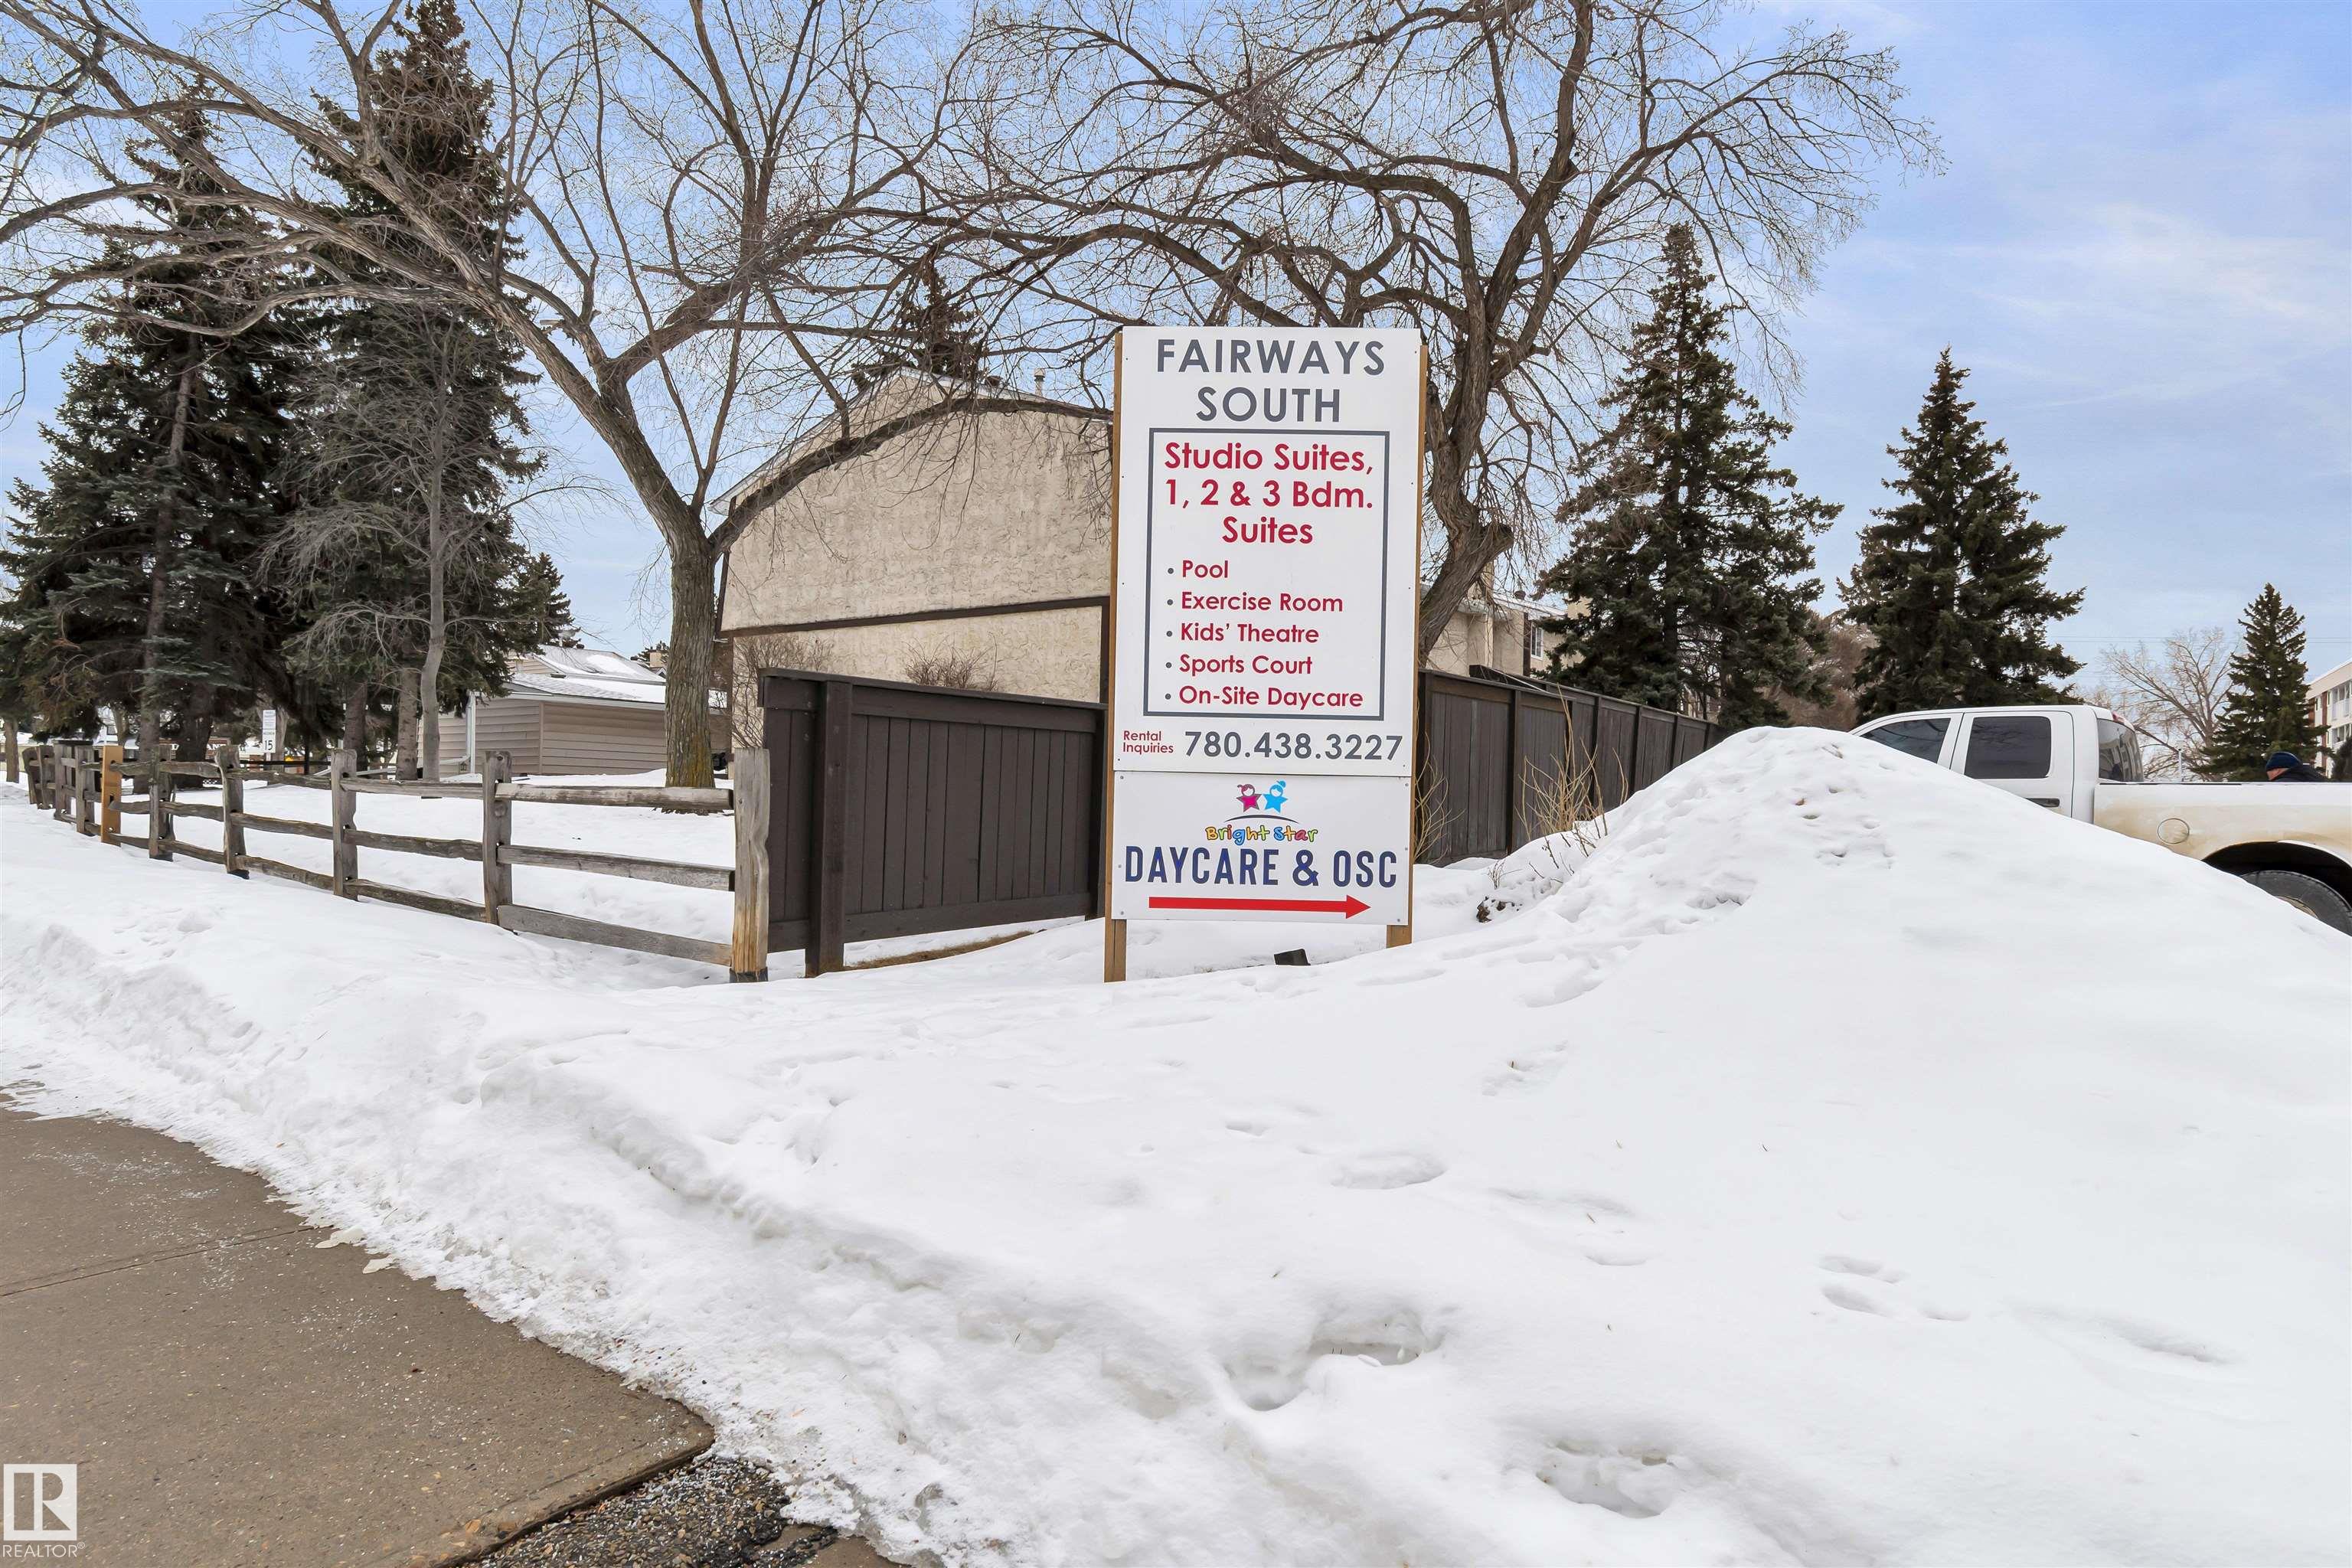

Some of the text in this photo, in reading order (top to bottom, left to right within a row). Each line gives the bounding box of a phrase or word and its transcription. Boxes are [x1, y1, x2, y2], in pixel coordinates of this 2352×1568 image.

[1157, 339, 1384, 376] FAIRWAYS
[1196, 387, 1340, 422] SOUTH
[1165, 442, 1373, 475] Studio Suites,
[1165, 479, 1373, 508] 1, 2 & 3 Bdm.
[1222, 516, 1313, 544] Suites
[1182, 560, 1228, 579] Pool
[1181, 592, 1343, 612] Exercise Room
[1181, 622, 1319, 643] Kids' Theatre
[1179, 655, 1313, 676] Sports Court
[1179, 686, 1364, 710] On-Site Daycare
[265, 740, 273, 750] 15
[1123, 730, 1161, 742] Rental
[1184, 731, 1403, 761] 780.438.3227
[1122, 742, 1174, 755] Inquiries
[1204, 824, 1318, 846] Bright Star
[1125, 846, 1397, 888] DAYCARE & OSC
